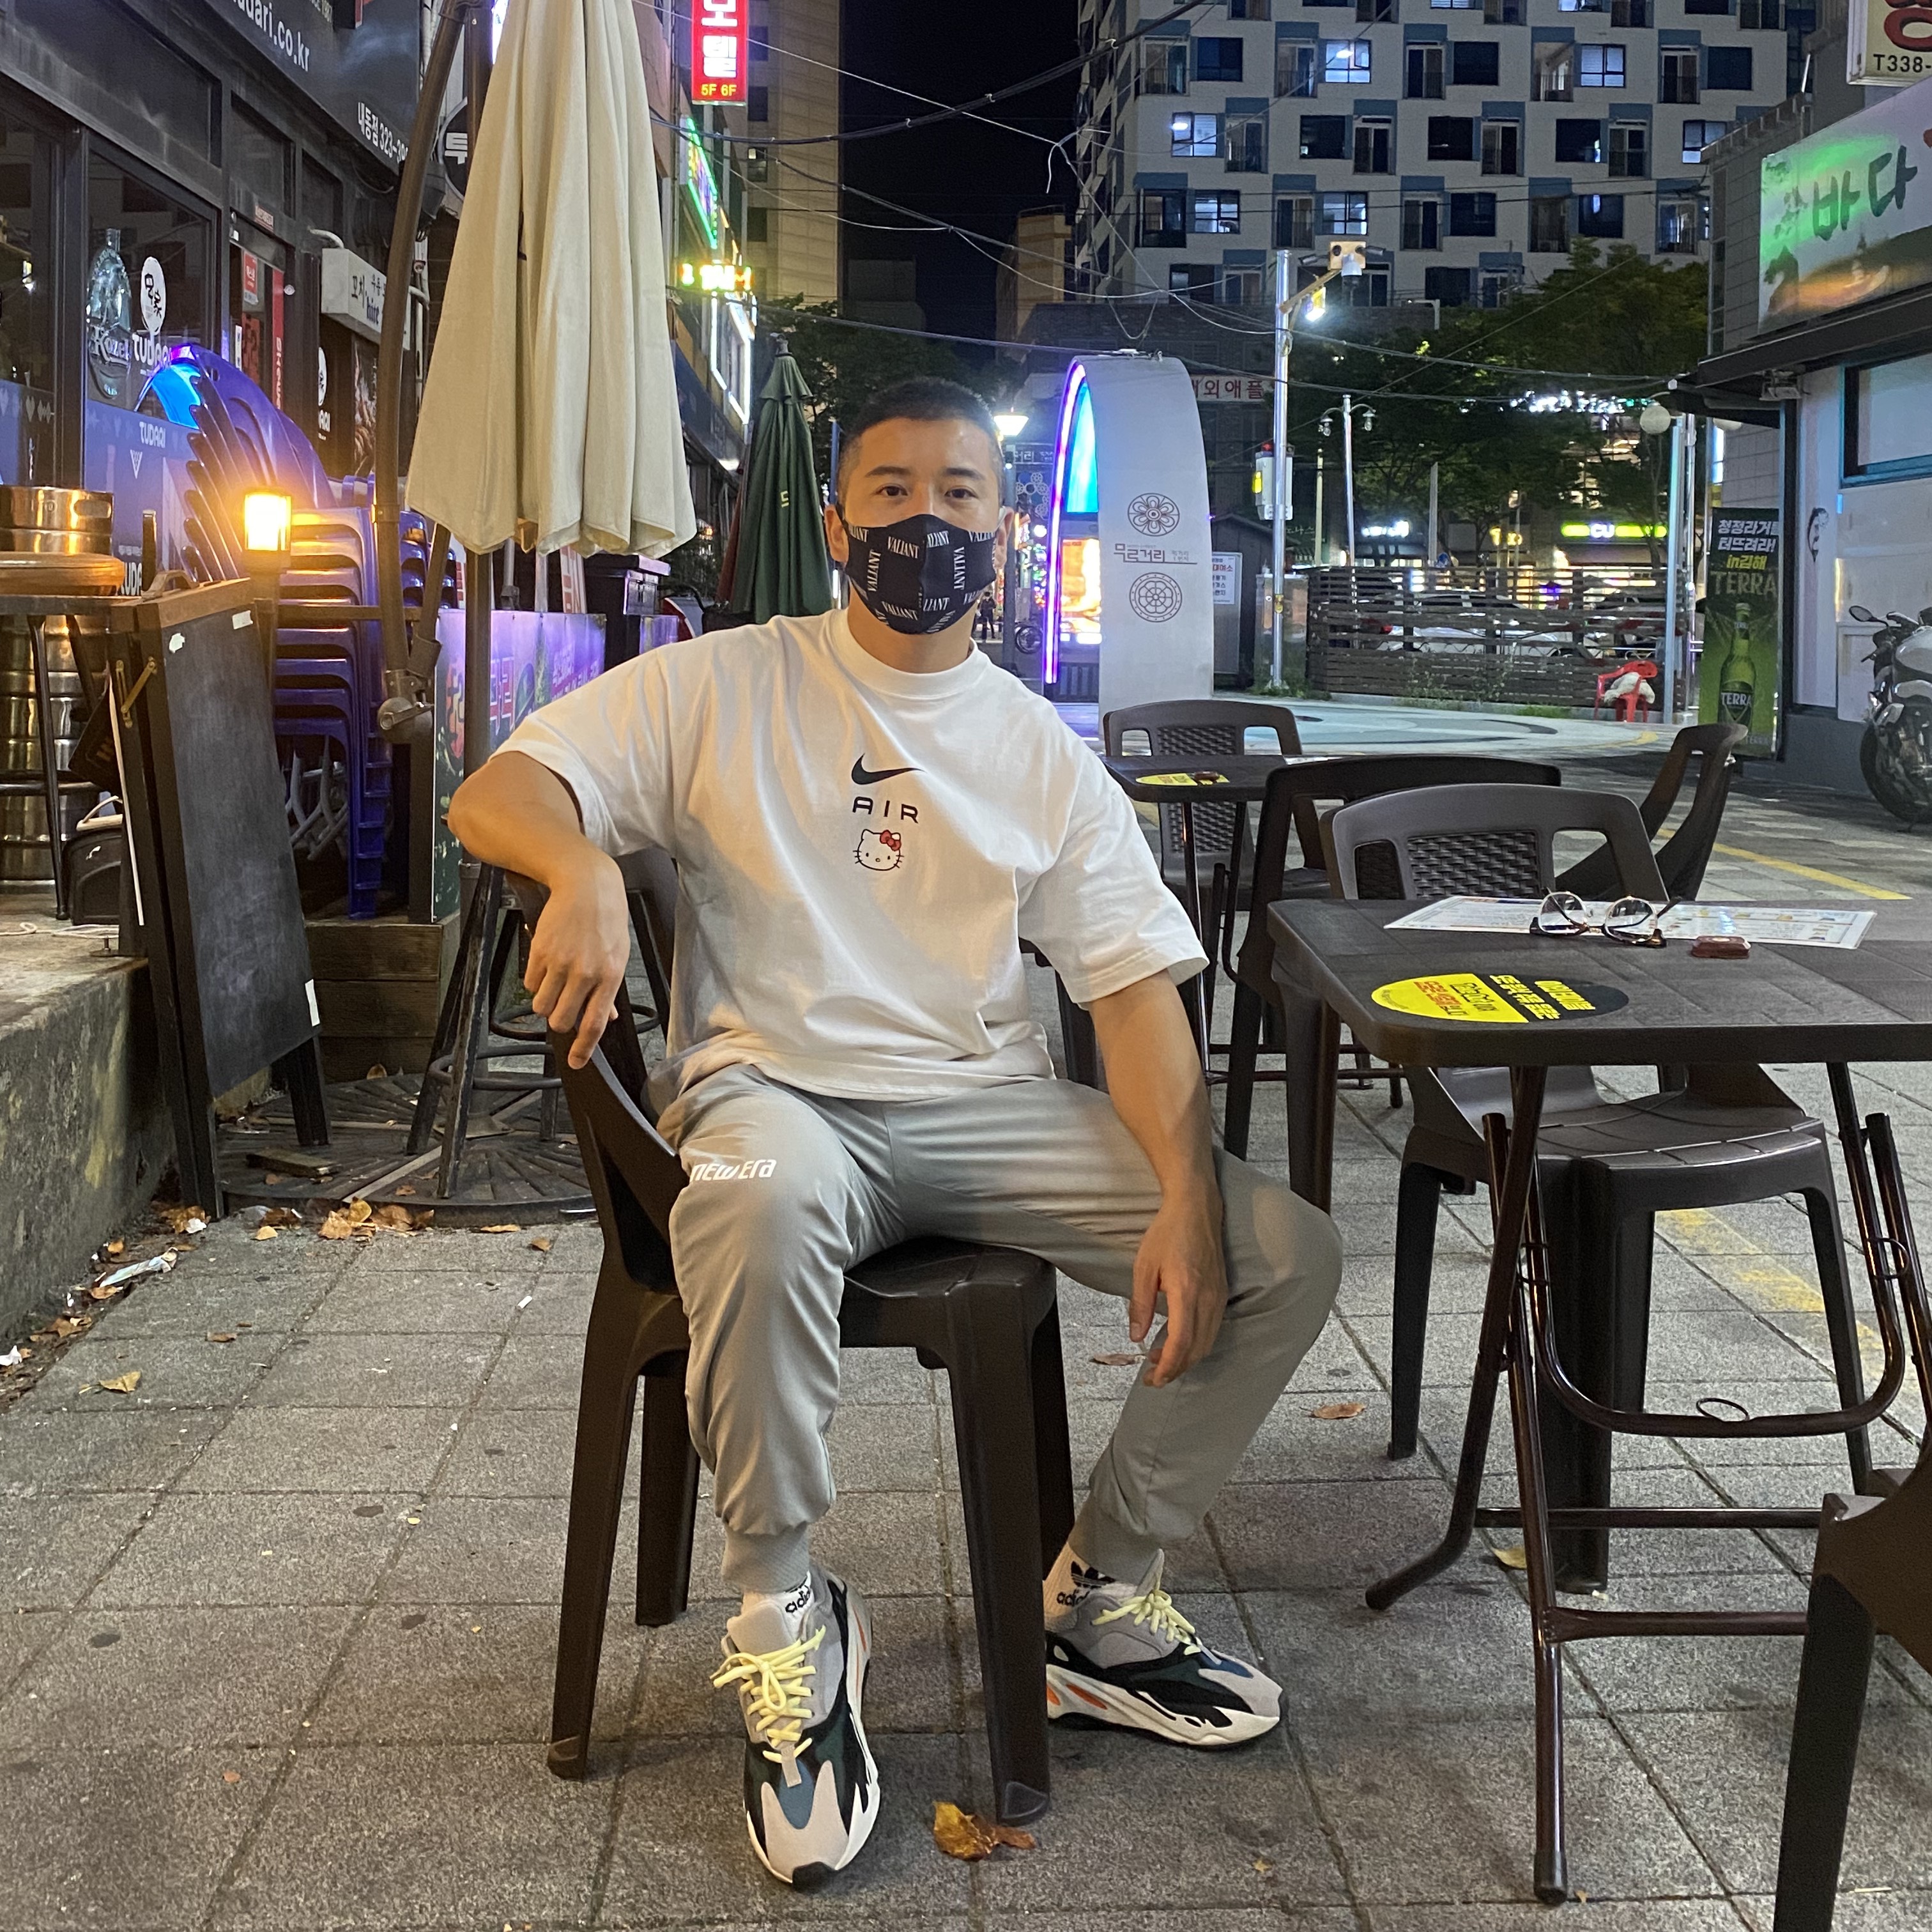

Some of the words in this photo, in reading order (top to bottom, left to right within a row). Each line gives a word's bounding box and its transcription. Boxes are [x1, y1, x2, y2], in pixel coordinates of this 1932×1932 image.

[233, 0, 310, 72] dari.co.kr
[701, 83, 717, 96] 5F
[720, 84, 737, 96] 6F
[1812, 144, 1919, 241] 바다
[887, 536, 920, 559] VALIANT
[867, 549, 882, 593] VALIANT
[953, 546, 966, 590] VALIANT
[1710, 571, 1779, 596] TERRA
[881, 600, 918, 620] VALIANT
[1721, 692, 1752, 706] TERRA
[852, 796, 919, 824] AIR
